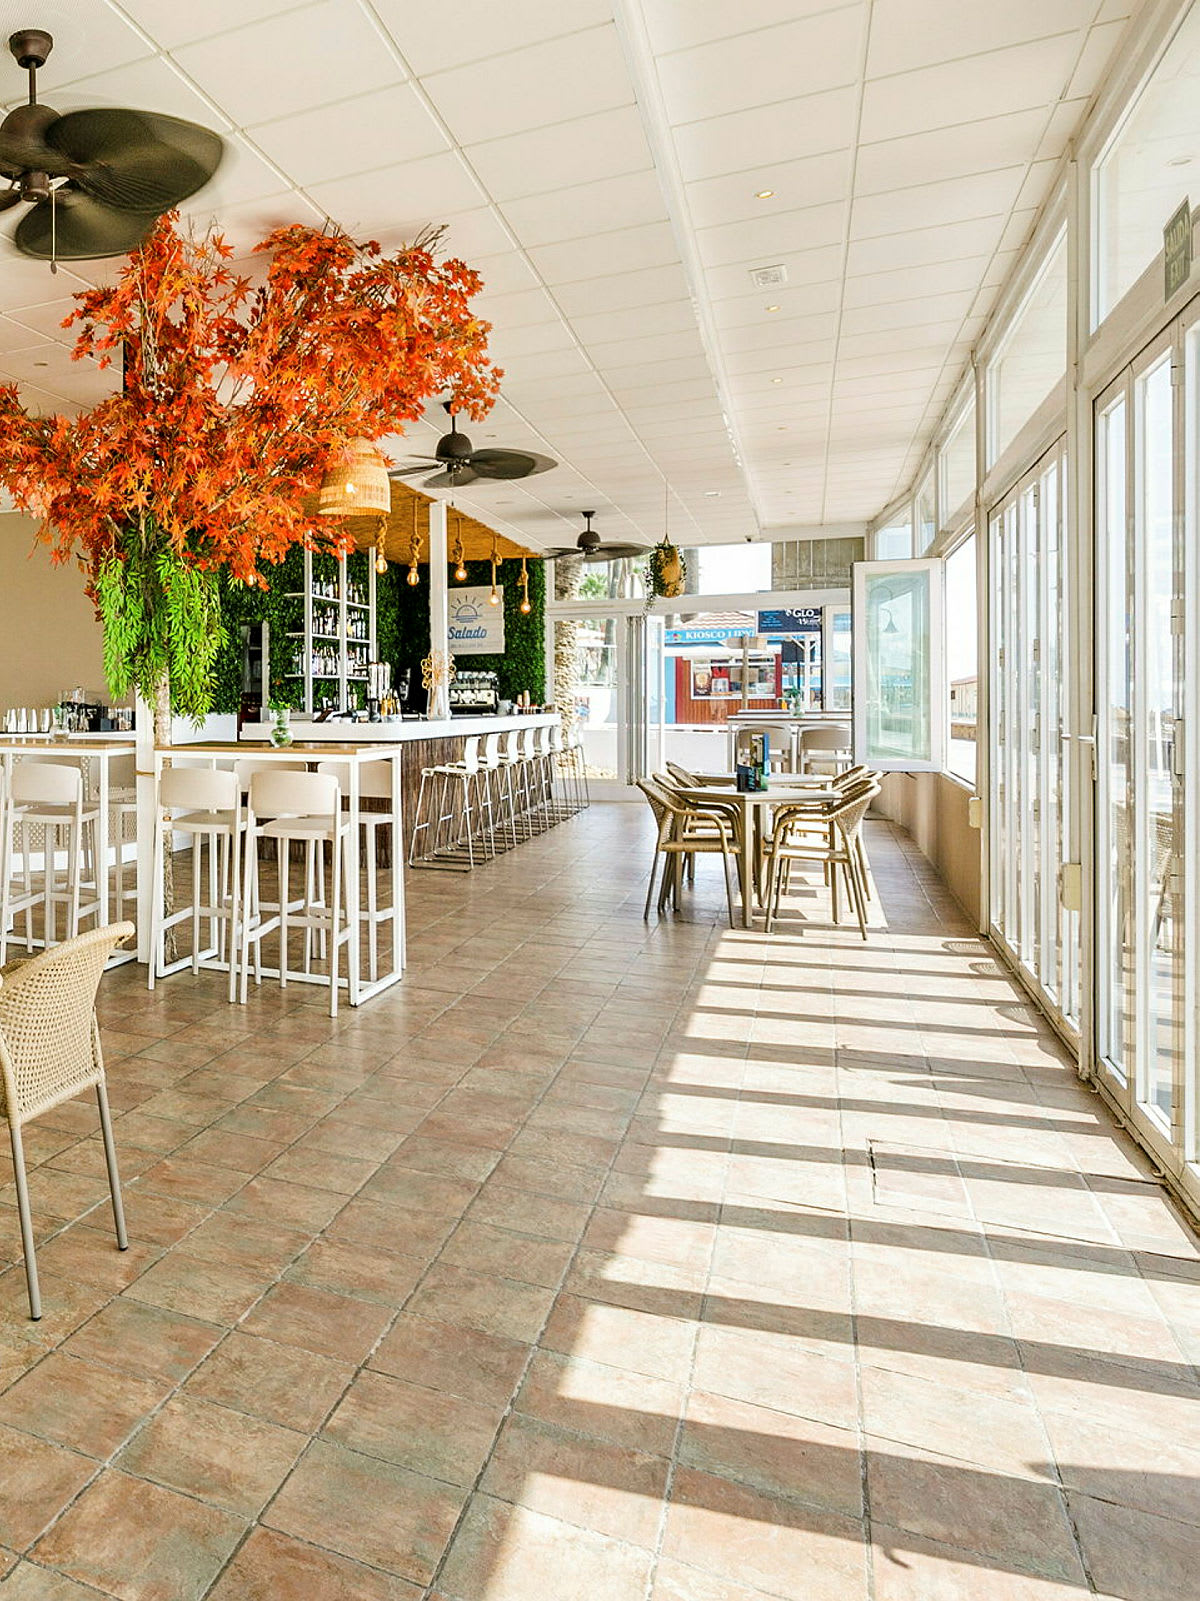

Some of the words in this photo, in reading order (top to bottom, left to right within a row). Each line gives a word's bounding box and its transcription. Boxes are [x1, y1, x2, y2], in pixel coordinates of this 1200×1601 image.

[1166, 213, 1190, 263] SALIDA
[1170, 249, 1186, 289] EXIT
[448, 626, 487, 640] Salado
[685, 630, 726, 640] KIOSCO
